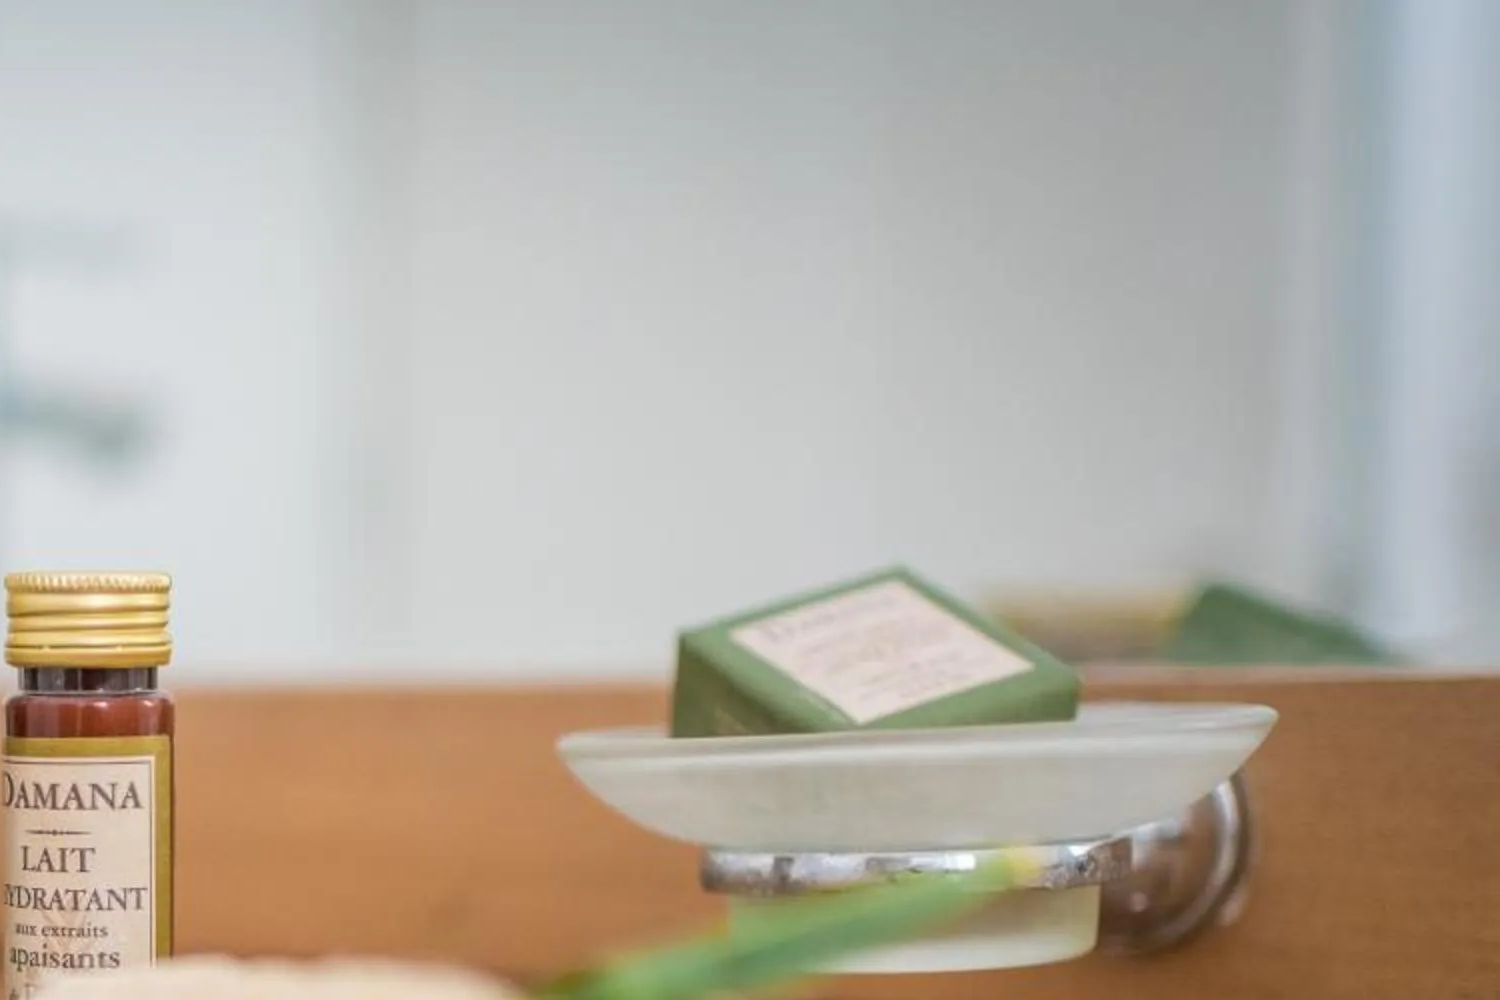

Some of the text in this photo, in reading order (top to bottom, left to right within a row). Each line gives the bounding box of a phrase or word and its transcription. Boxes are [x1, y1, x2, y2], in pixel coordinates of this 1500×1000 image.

[20, 845, 96, 873] LAIT
[4, 883, 148, 912] YDRATANT
[15, 922, 109, 938] aux extraits
[10, 944, 121, 972] apaisants
